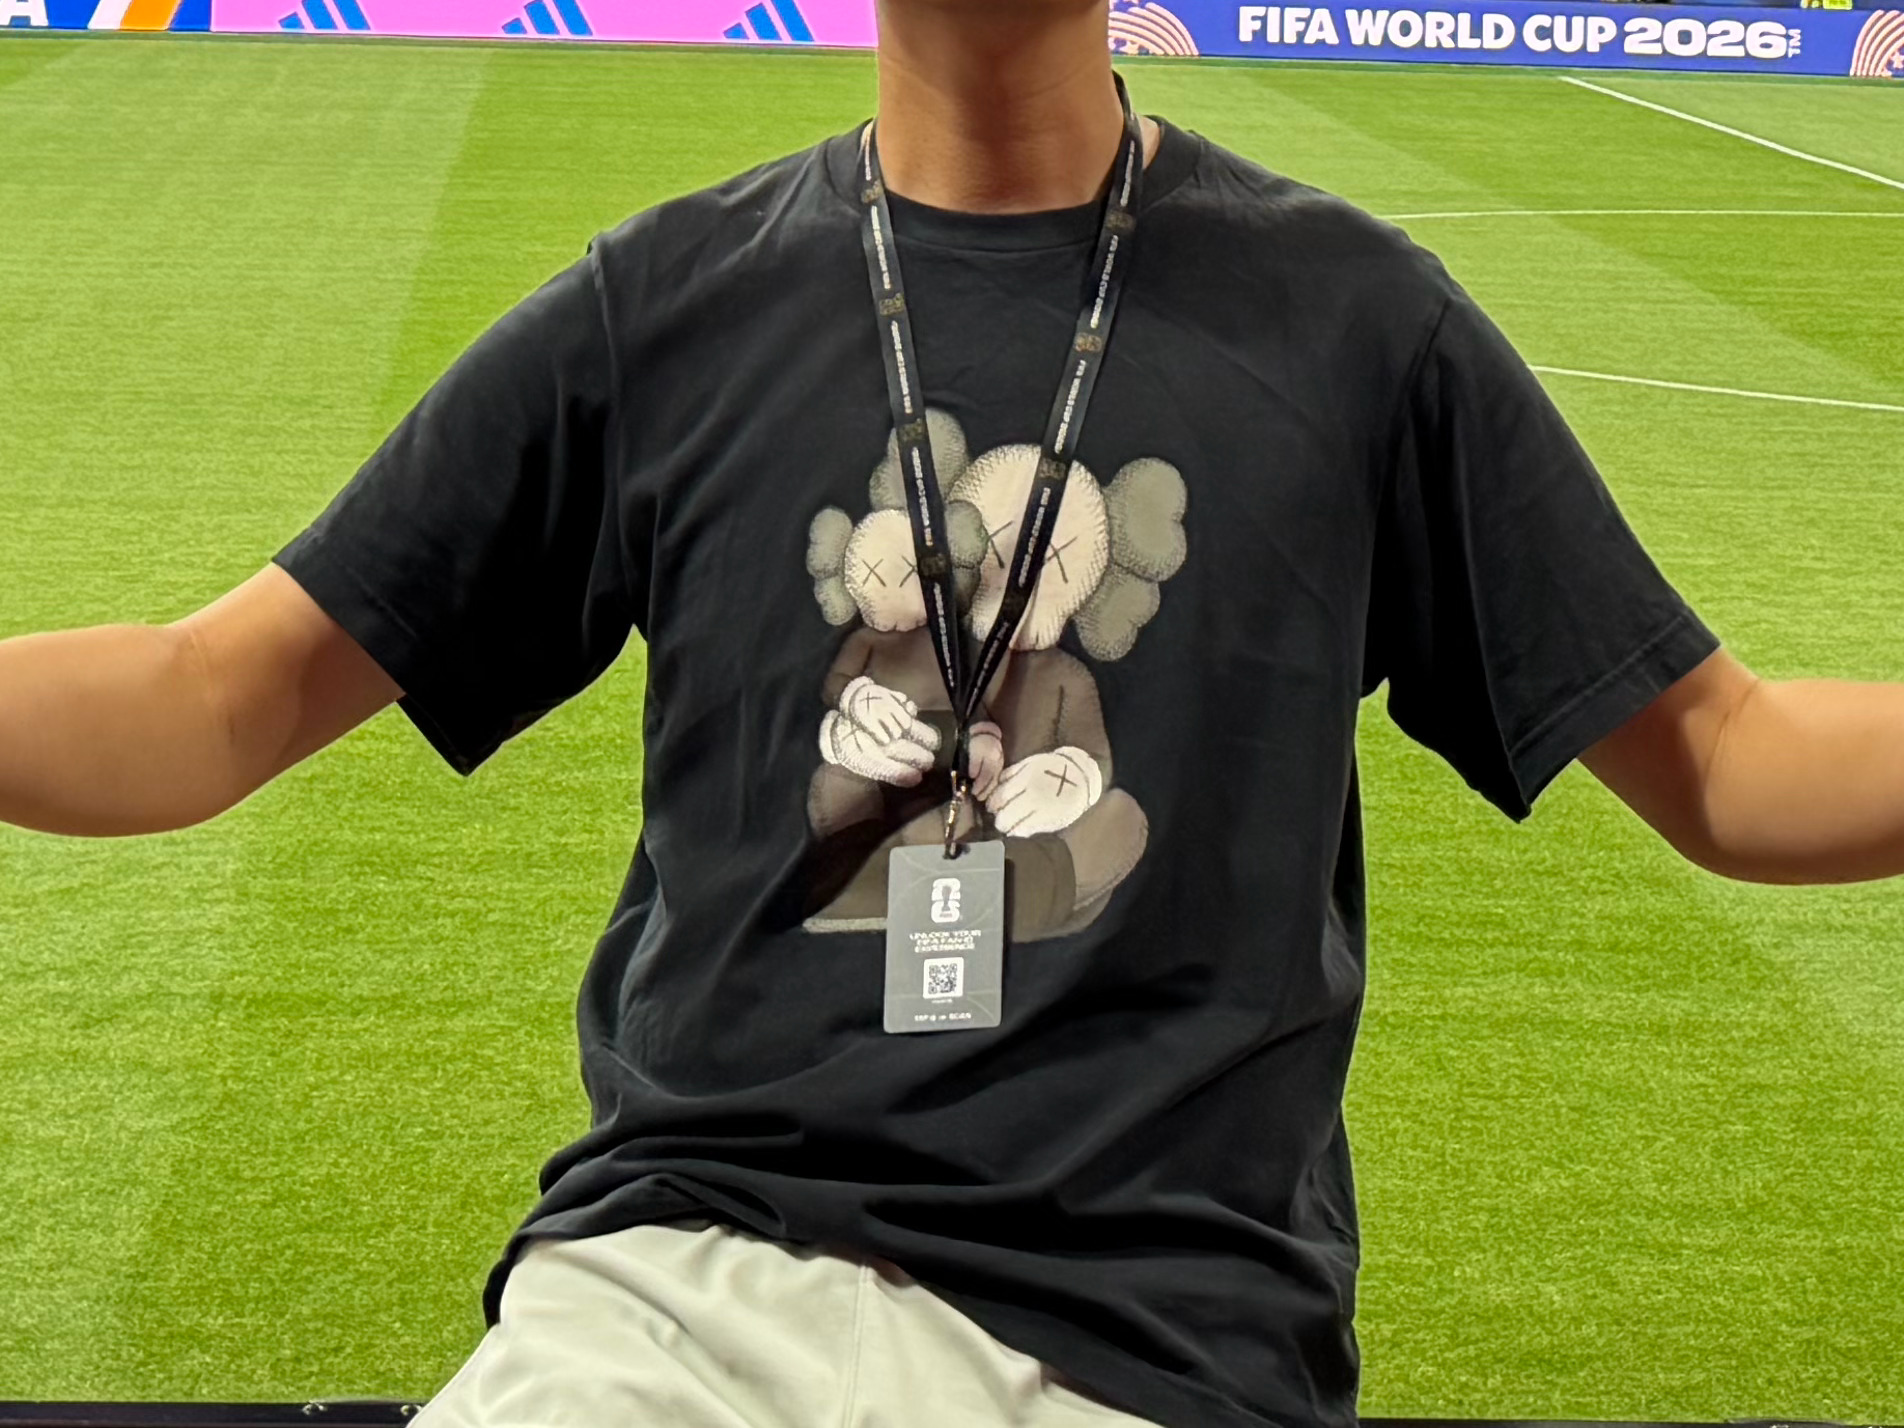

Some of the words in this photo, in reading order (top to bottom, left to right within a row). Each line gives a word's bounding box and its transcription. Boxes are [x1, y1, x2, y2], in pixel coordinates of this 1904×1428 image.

[1239, 6, 1339, 44] FIFA
[1346, 9, 1515, 49] WORLD
[1523, 15, 1617, 52] CUP
[1624, 18, 1787, 58] 2026
